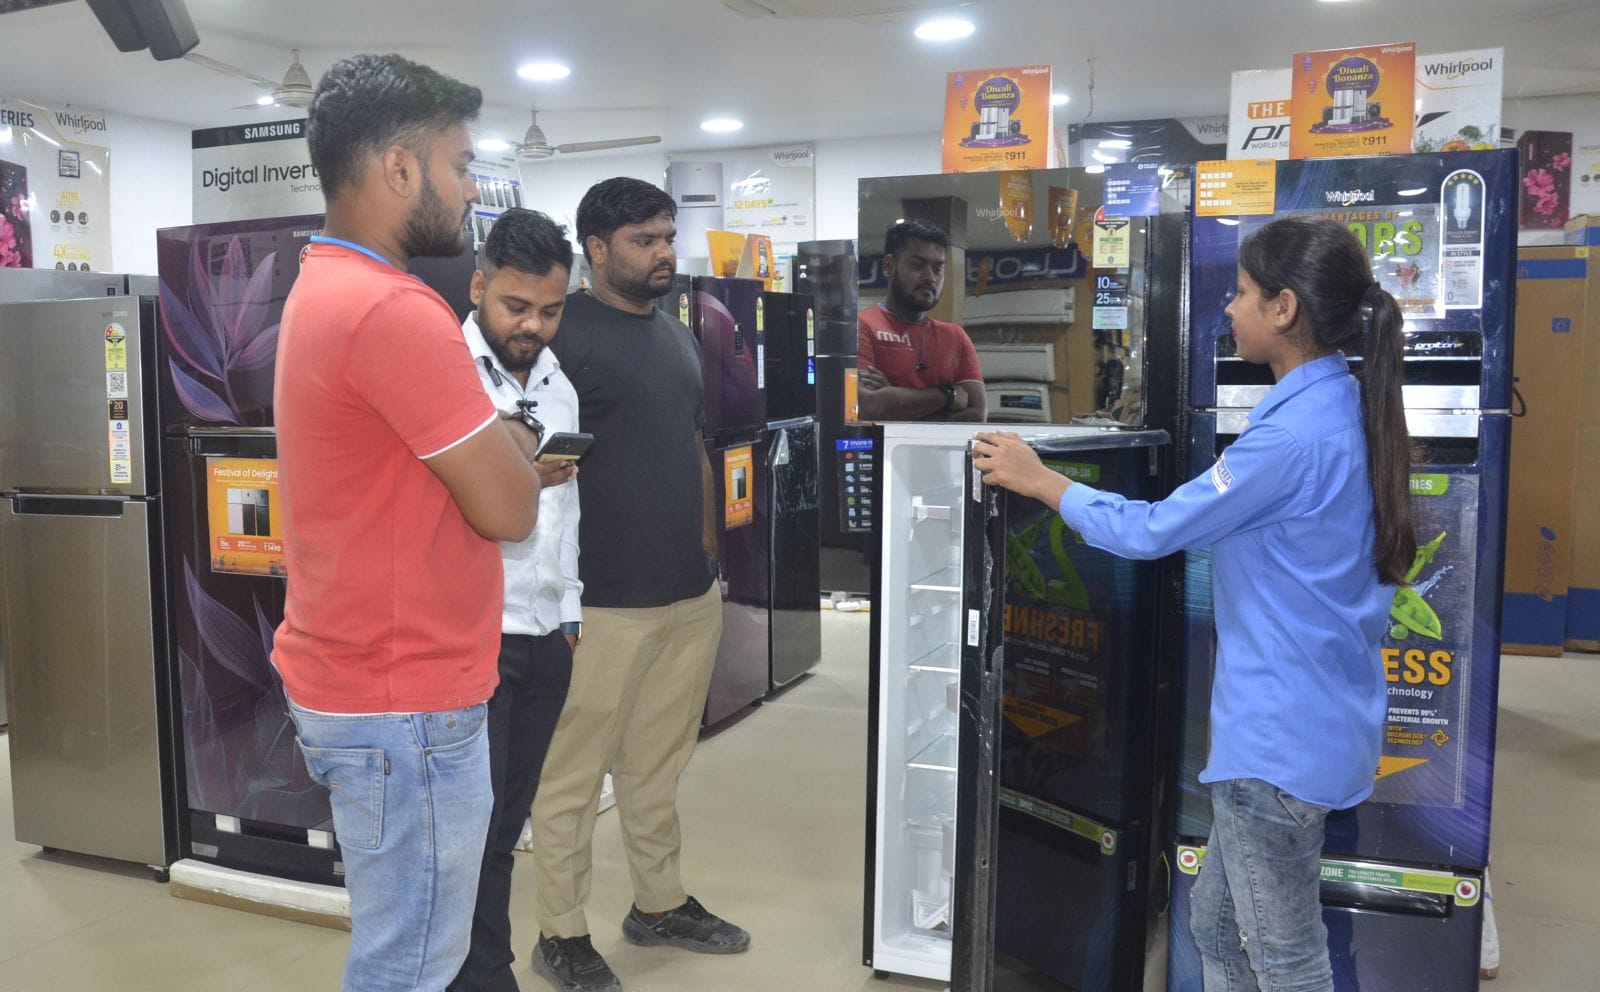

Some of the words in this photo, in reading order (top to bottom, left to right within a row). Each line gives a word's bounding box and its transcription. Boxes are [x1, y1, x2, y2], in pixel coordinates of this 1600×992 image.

[1381, 45, 1413, 54] Whirlpool
[1338, 65, 1369, 75] Diwali
[1424, 57, 1493, 76] Whirlpool
[1333, 74, 1373, 83] Bonanza
[985, 85, 1012, 93] Diwali
[981, 92, 1015, 100] Bonanza
[1251, 102, 1285, 118] THE
[55, 111, 106, 133] Whirlpool
[244, 122, 300, 140] SAMSUNG
[1251, 142, 1277, 150] WORLD
[773, 150, 809, 161] Whirlpool
[202, 165, 258, 192] Digital
[262, 163, 320, 183] Invert
[1325, 189, 1375, 203] Whirlpool
[745, 199, 768, 209] DAYS
[1097, 276, 1110, 289] 10
[1096, 292, 1110, 305] 25
[842, 440, 849, 450] 7
[214, 467, 241, 477] Festival
[242, 469, 251, 478] of
[252, 469, 278, 480] Delight
[1380, 648, 1453, 686] ESS
[1387, 686, 1434, 700] chnology
[1388, 707, 1420, 716] PREVENTS
[1388, 715, 1421, 724] BACTERIAL
[1422, 717, 1449, 725] GROWTH
[1320, 866, 1344, 878] ZONE
